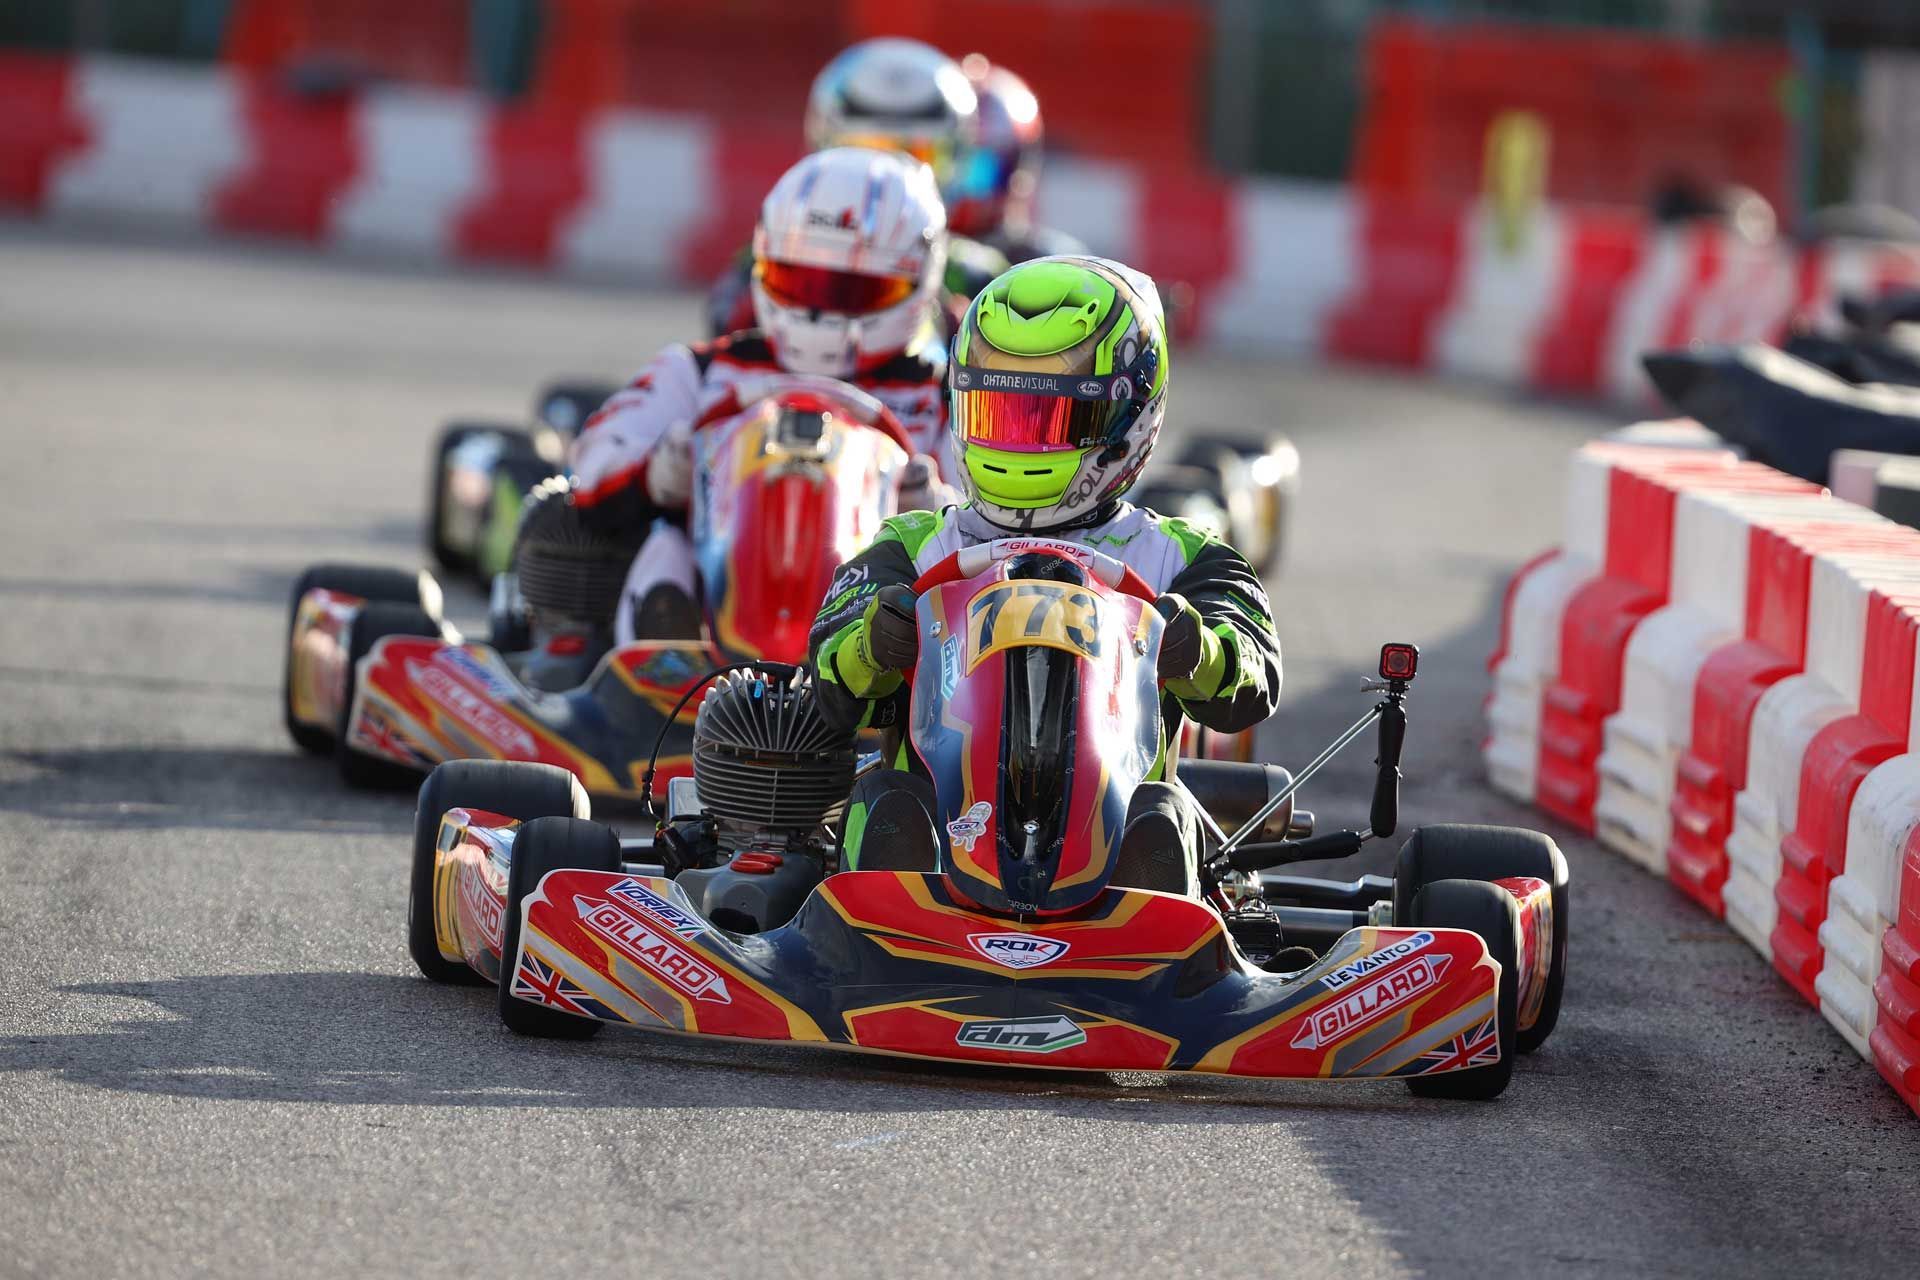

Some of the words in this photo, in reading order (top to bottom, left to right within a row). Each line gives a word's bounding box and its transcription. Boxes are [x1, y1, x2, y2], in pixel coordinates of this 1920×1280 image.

[1079, 383, 1102, 394] Arai
[971, 585, 1101, 657] 773
[594, 909, 714, 989] GILLARD
[985, 939, 1050, 953] ROK
[996, 952, 1040, 961] CUP
[1325, 943, 1411, 987] LEVANTO
[1318, 963, 1429, 1037] GILLARD
